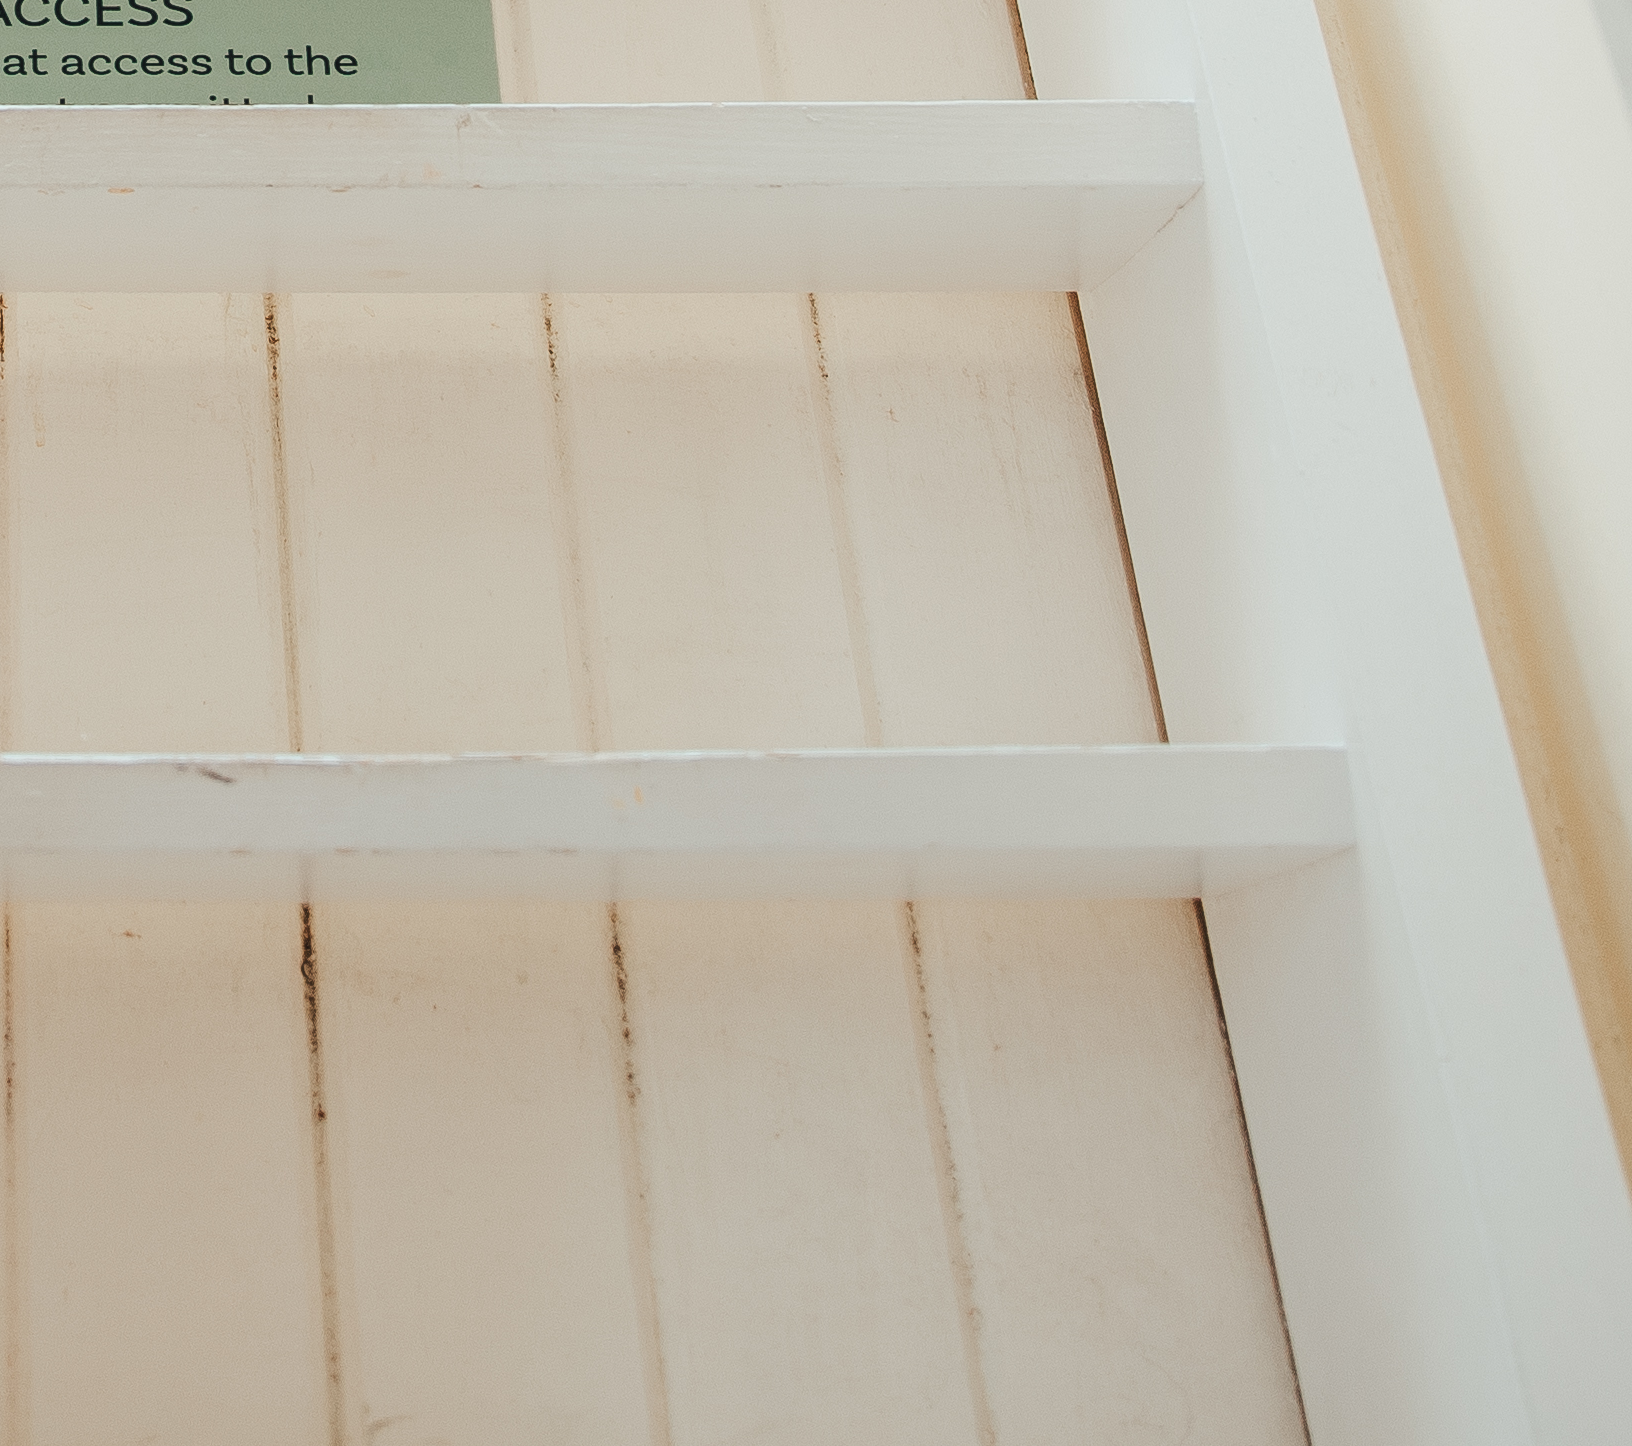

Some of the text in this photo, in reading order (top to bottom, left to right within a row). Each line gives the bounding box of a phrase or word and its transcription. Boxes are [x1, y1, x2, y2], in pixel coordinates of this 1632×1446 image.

[60, 53, 214, 77] access
[223, 47, 273, 77] to
[282, 43, 360, 77] the
